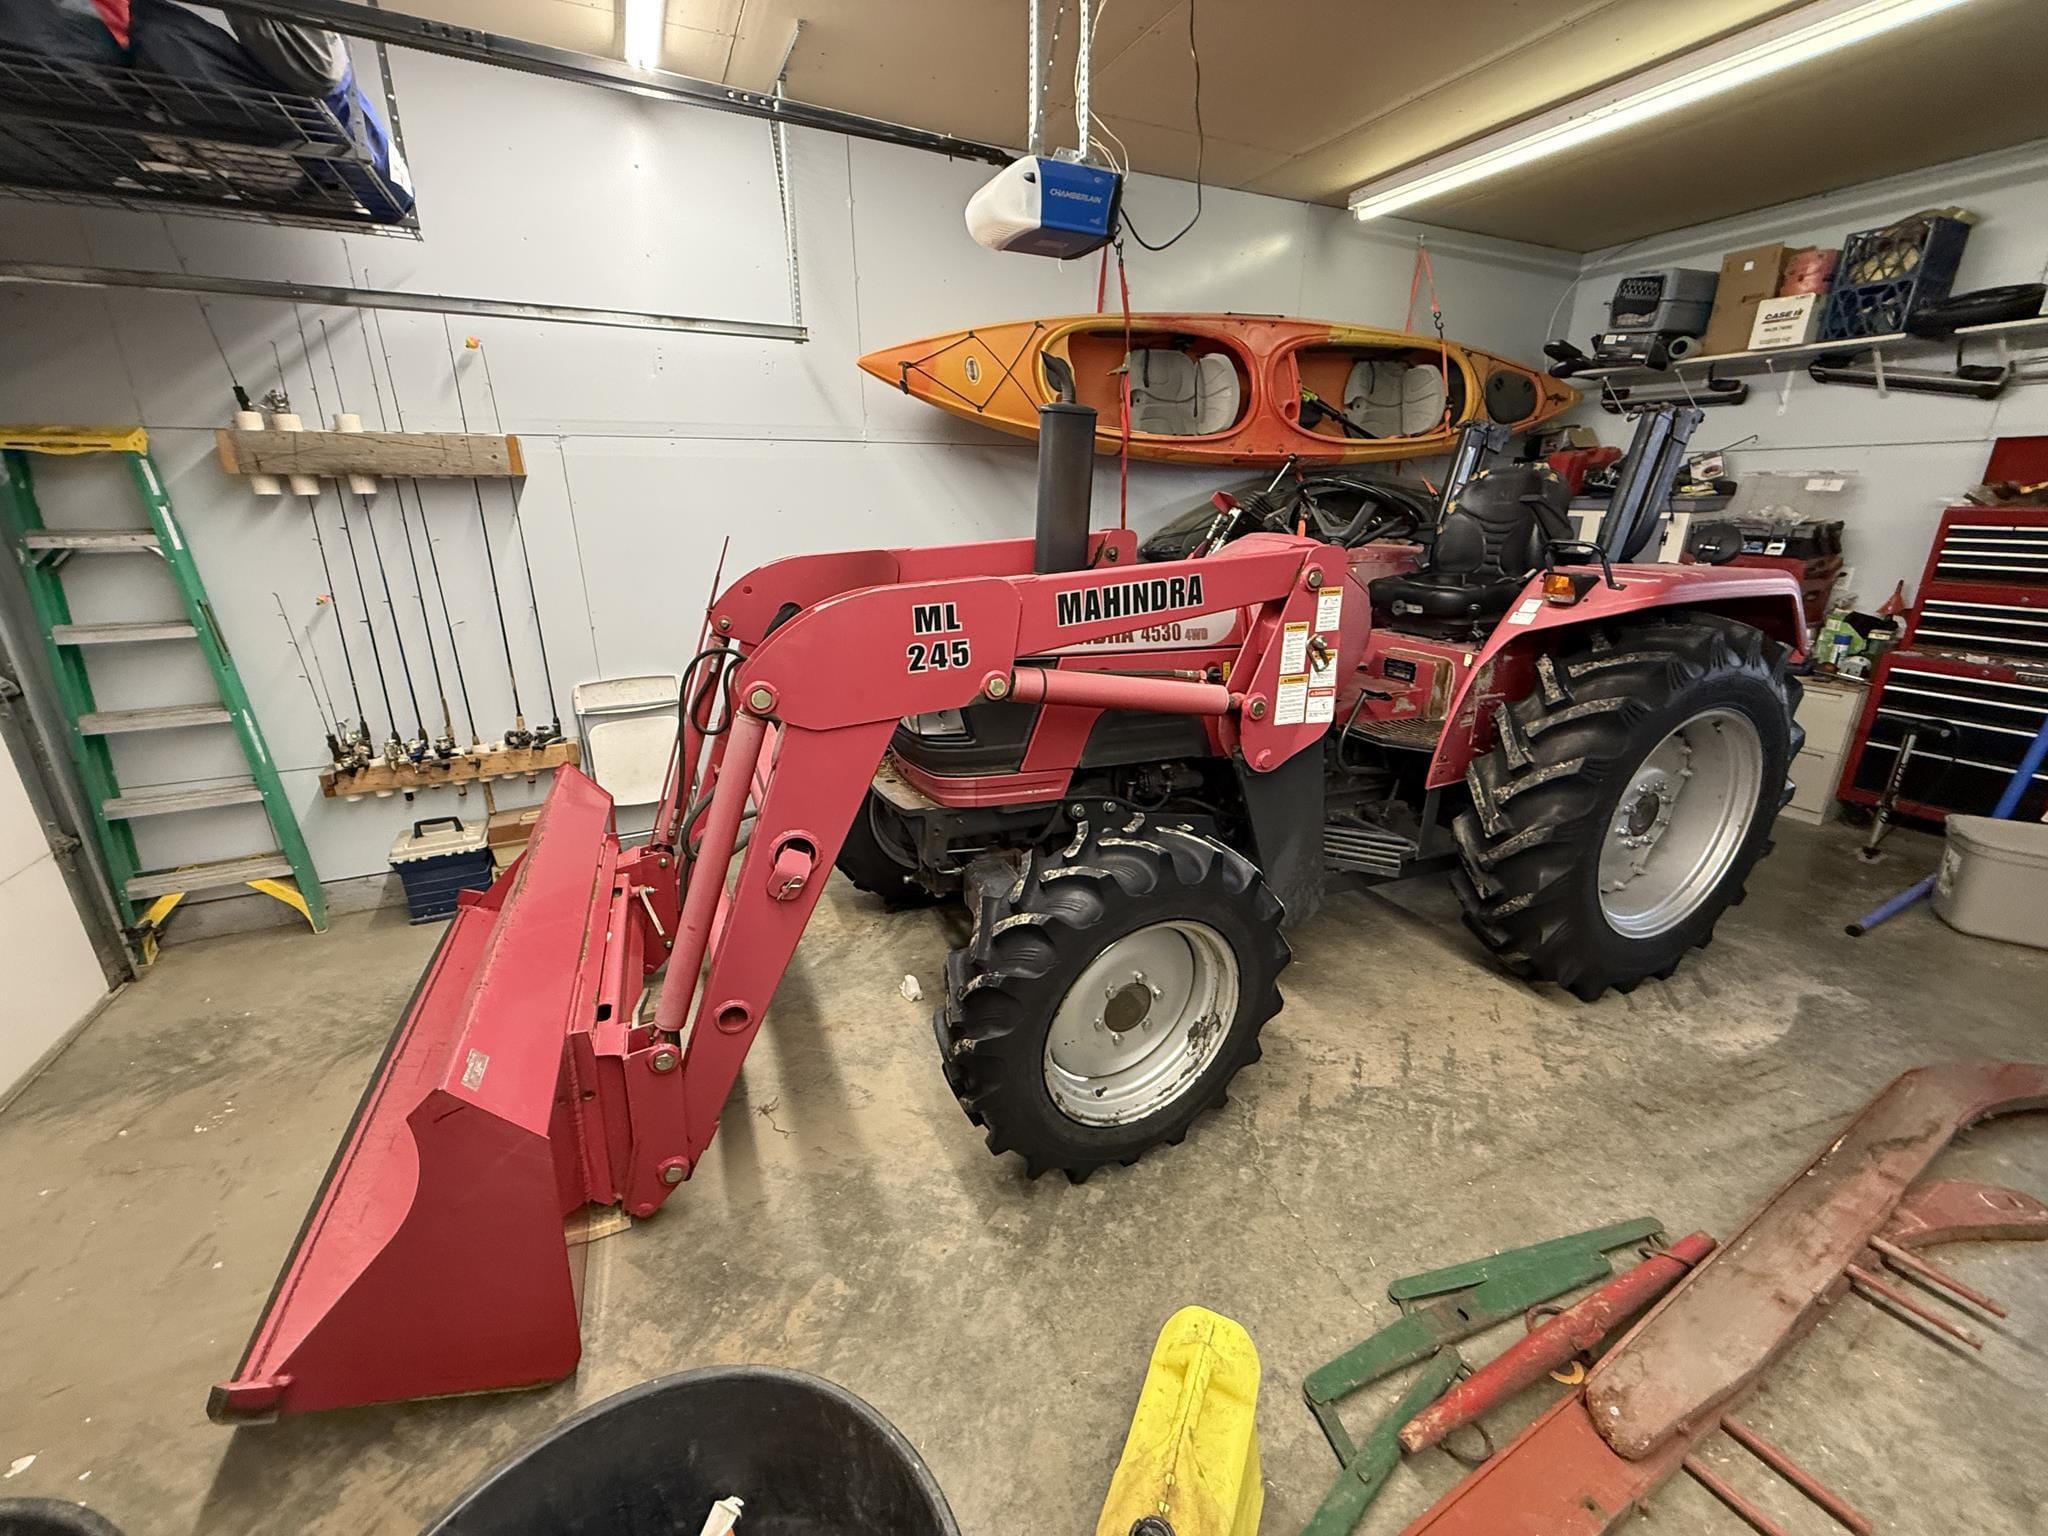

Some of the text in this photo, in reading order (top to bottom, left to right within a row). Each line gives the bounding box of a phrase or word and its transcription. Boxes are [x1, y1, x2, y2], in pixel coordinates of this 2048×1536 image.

[1050, 187, 1102, 204] CHAMBERLAIN
[1765, 310, 1793, 321] CASE
[1057, 574, 1203, 626] MAHINDRA
[913, 603, 962, 634] ML
[1141, 623, 1182, 643] 4530
[1185, 627, 1209, 641] 4WD
[908, 640, 970, 673] 245
